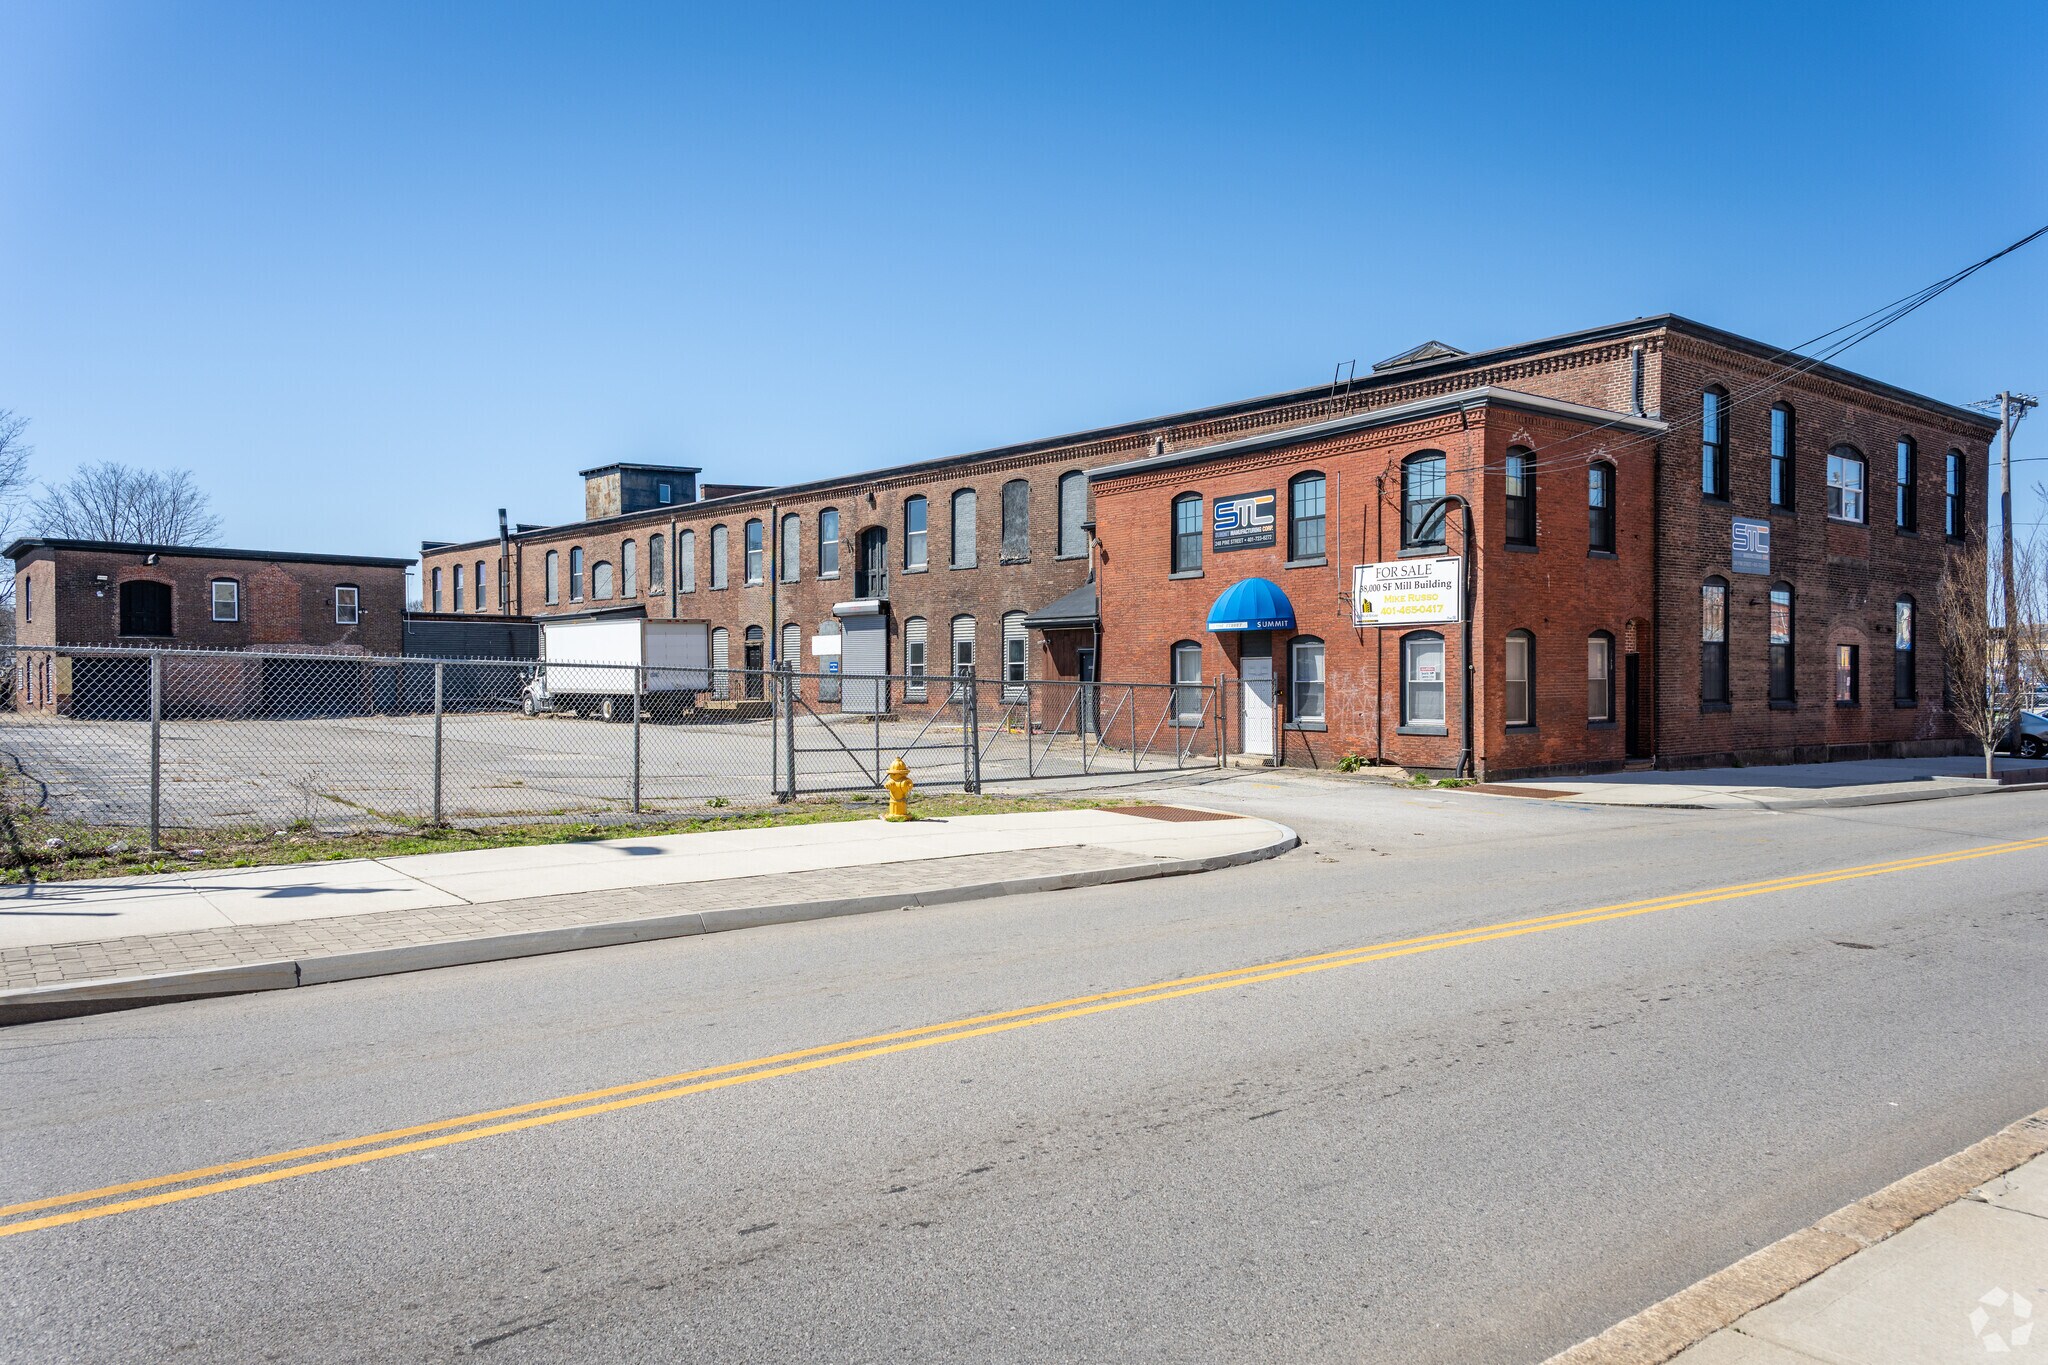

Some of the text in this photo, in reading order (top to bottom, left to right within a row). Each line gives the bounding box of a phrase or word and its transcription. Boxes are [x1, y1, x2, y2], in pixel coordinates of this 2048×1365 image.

[1230, 527, 1261, 536] MANUFACTURING
[1376, 564, 1432, 578] FOR SALE
[1383, 583, 1392, 591] SF
[1395, 581, 1412, 590] Mill
[1414, 580, 1452, 590] Building
[1381, 604, 1443, 615] 401-465-0417
[1257, 620, 1288, 628] SUMMIT
